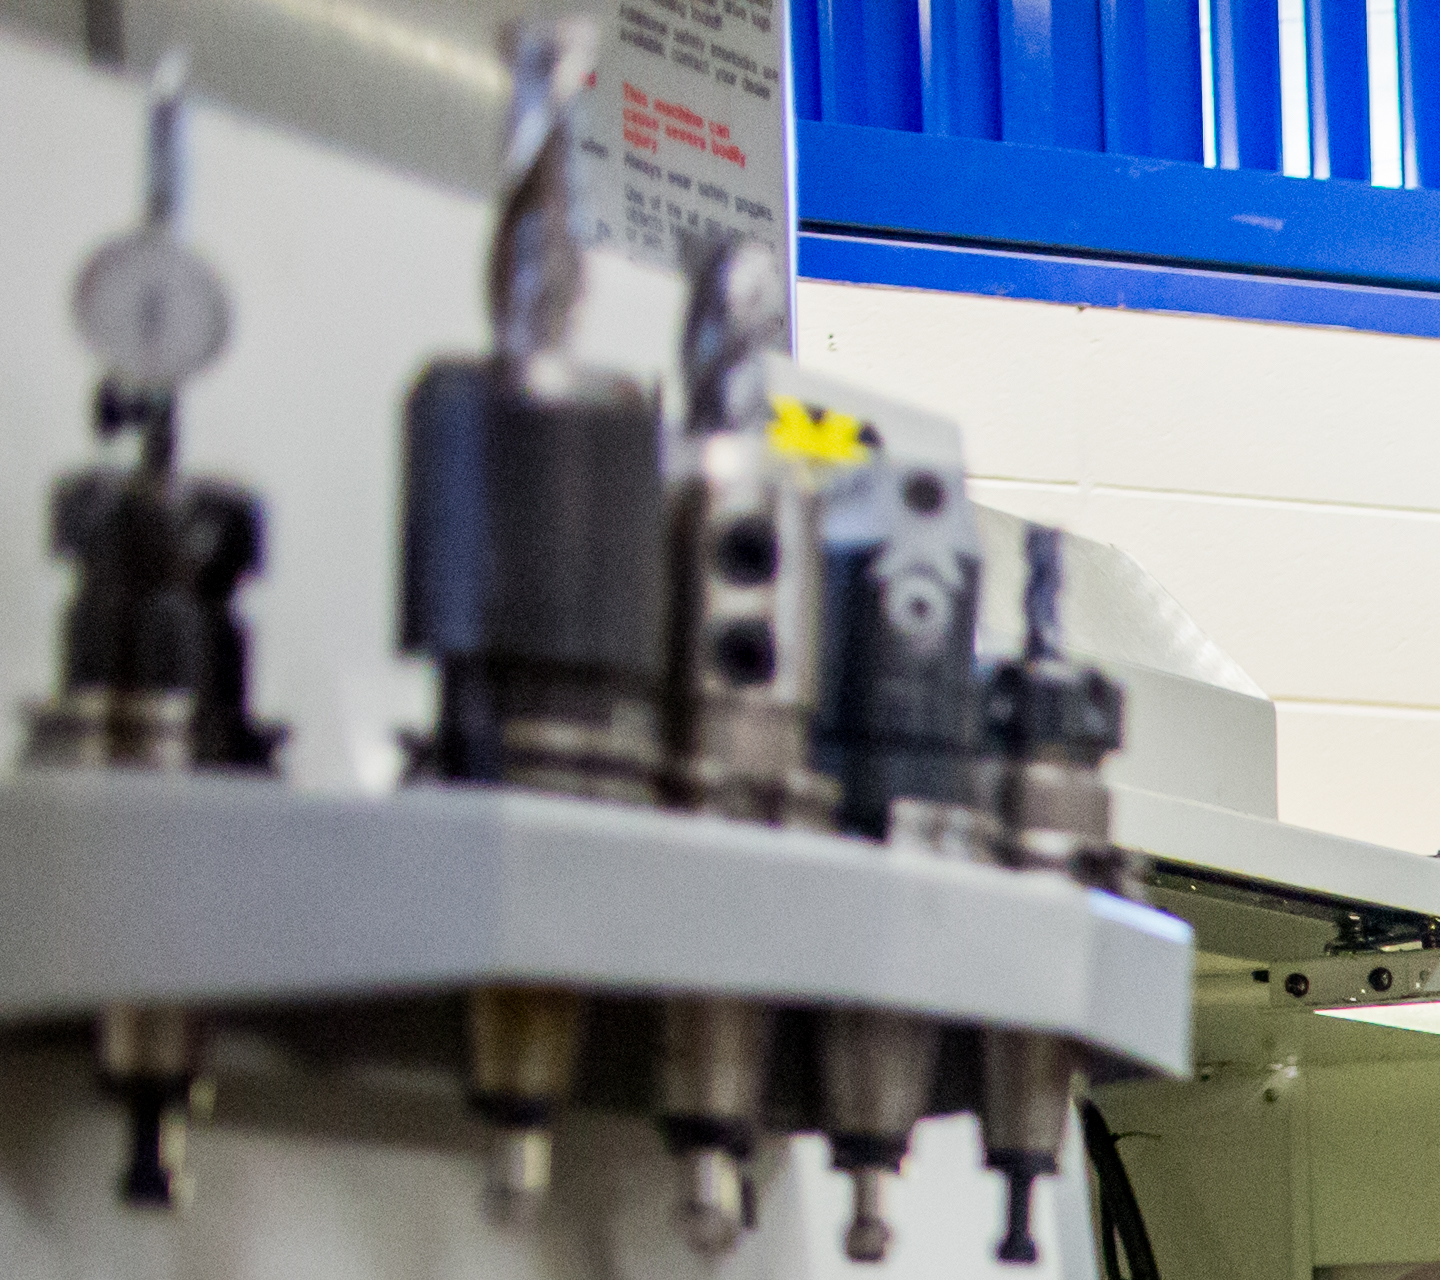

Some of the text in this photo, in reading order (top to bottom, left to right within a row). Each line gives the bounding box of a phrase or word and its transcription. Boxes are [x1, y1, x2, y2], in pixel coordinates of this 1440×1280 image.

[623, 81, 730, 139] This machine can
[623, 108, 659, 132] cause
[711, 139, 746, 169] bodily
[667, 170, 692, 190] wear
[698, 181, 729, 208] safety
